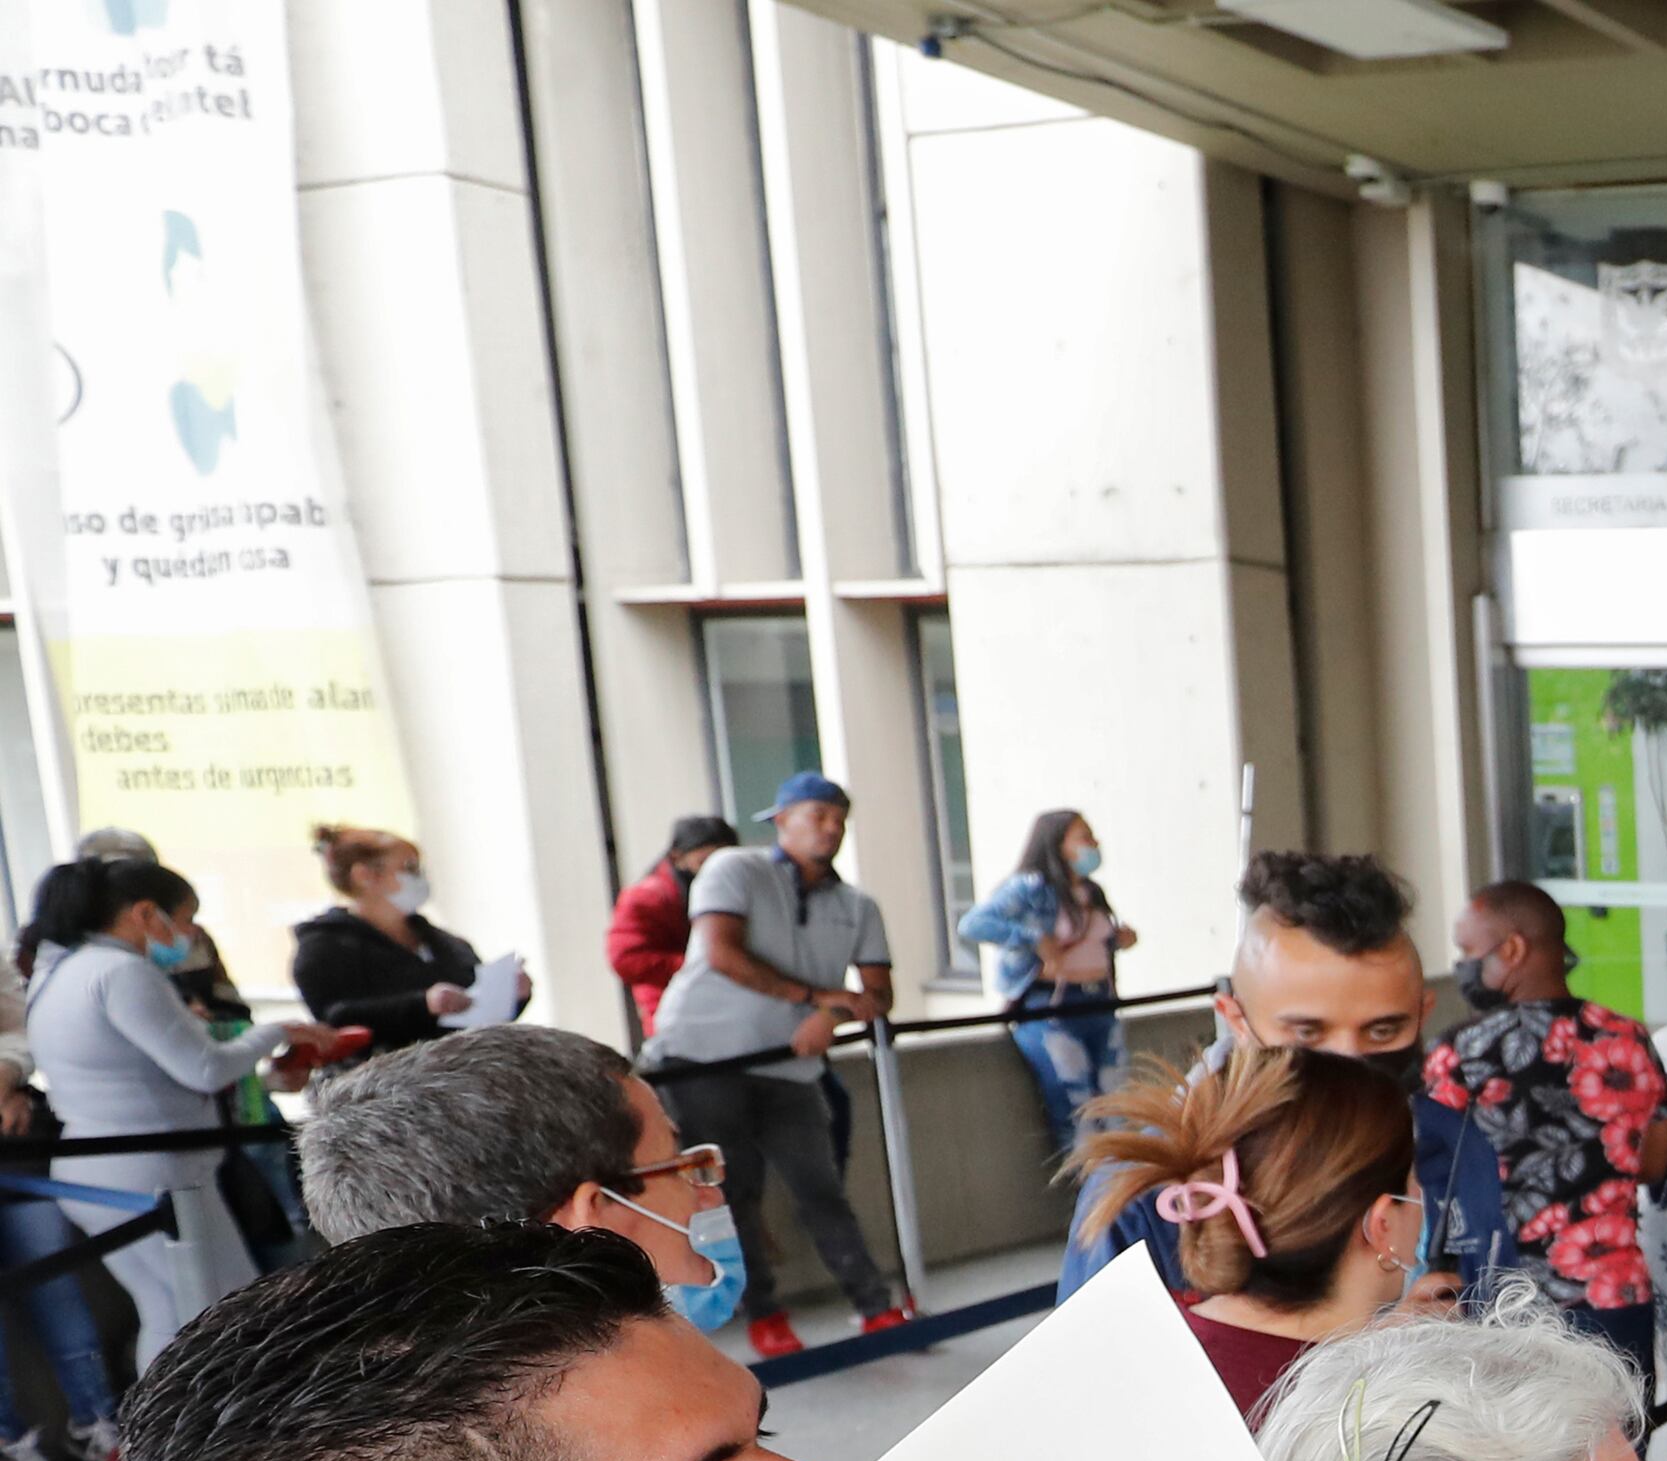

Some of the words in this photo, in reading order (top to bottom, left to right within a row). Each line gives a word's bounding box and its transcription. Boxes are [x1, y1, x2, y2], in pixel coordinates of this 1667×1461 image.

[118, 505, 159, 535] de
[102, 555, 120, 587] y
[116, 761, 197, 791] antes
[202, 760, 232, 790] de
